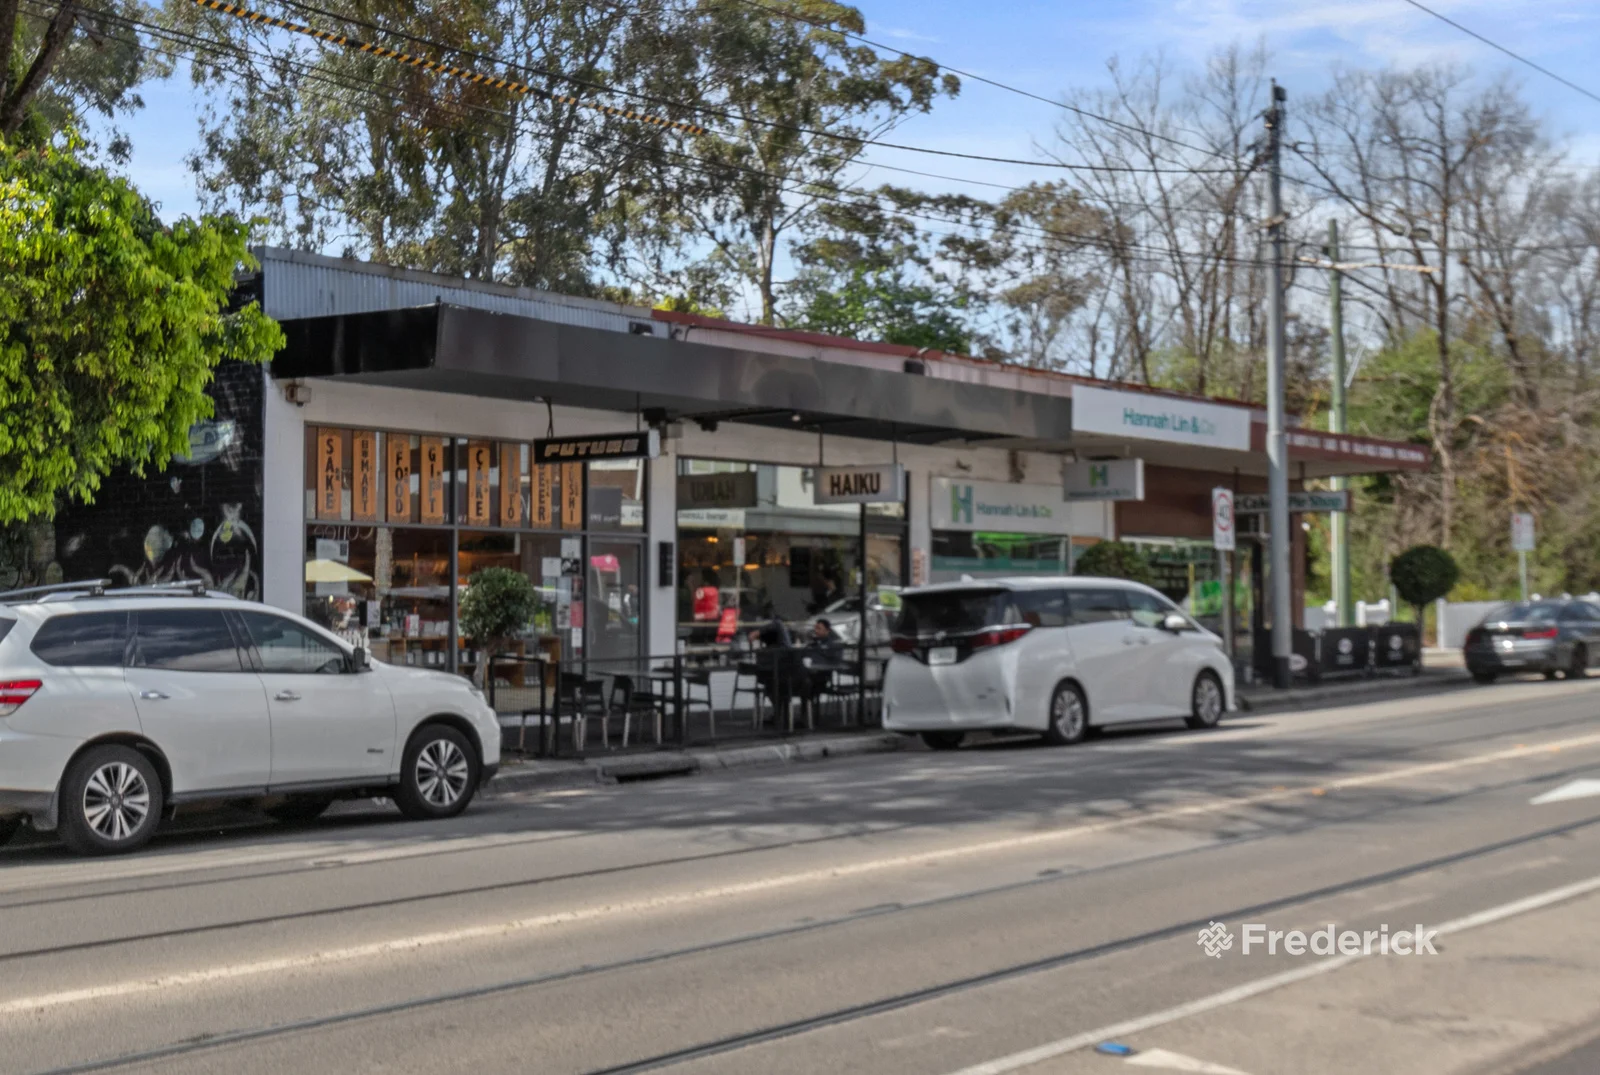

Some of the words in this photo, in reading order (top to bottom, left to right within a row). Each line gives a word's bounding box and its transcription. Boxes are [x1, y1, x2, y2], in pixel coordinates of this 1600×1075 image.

[1123, 407, 1169, 429] Hannah
[1171, 413, 1190, 432] Lin
[1191, 416, 1199, 434] &
[544, 439, 639, 457] FUTURE
[325, 438, 334, 510] SAKE
[395, 451, 404, 514] FOOD
[830, 473, 881, 497] HAIKU
[976, 501, 1012, 516] Hannah
[1015, 504, 1030, 517] Lin
